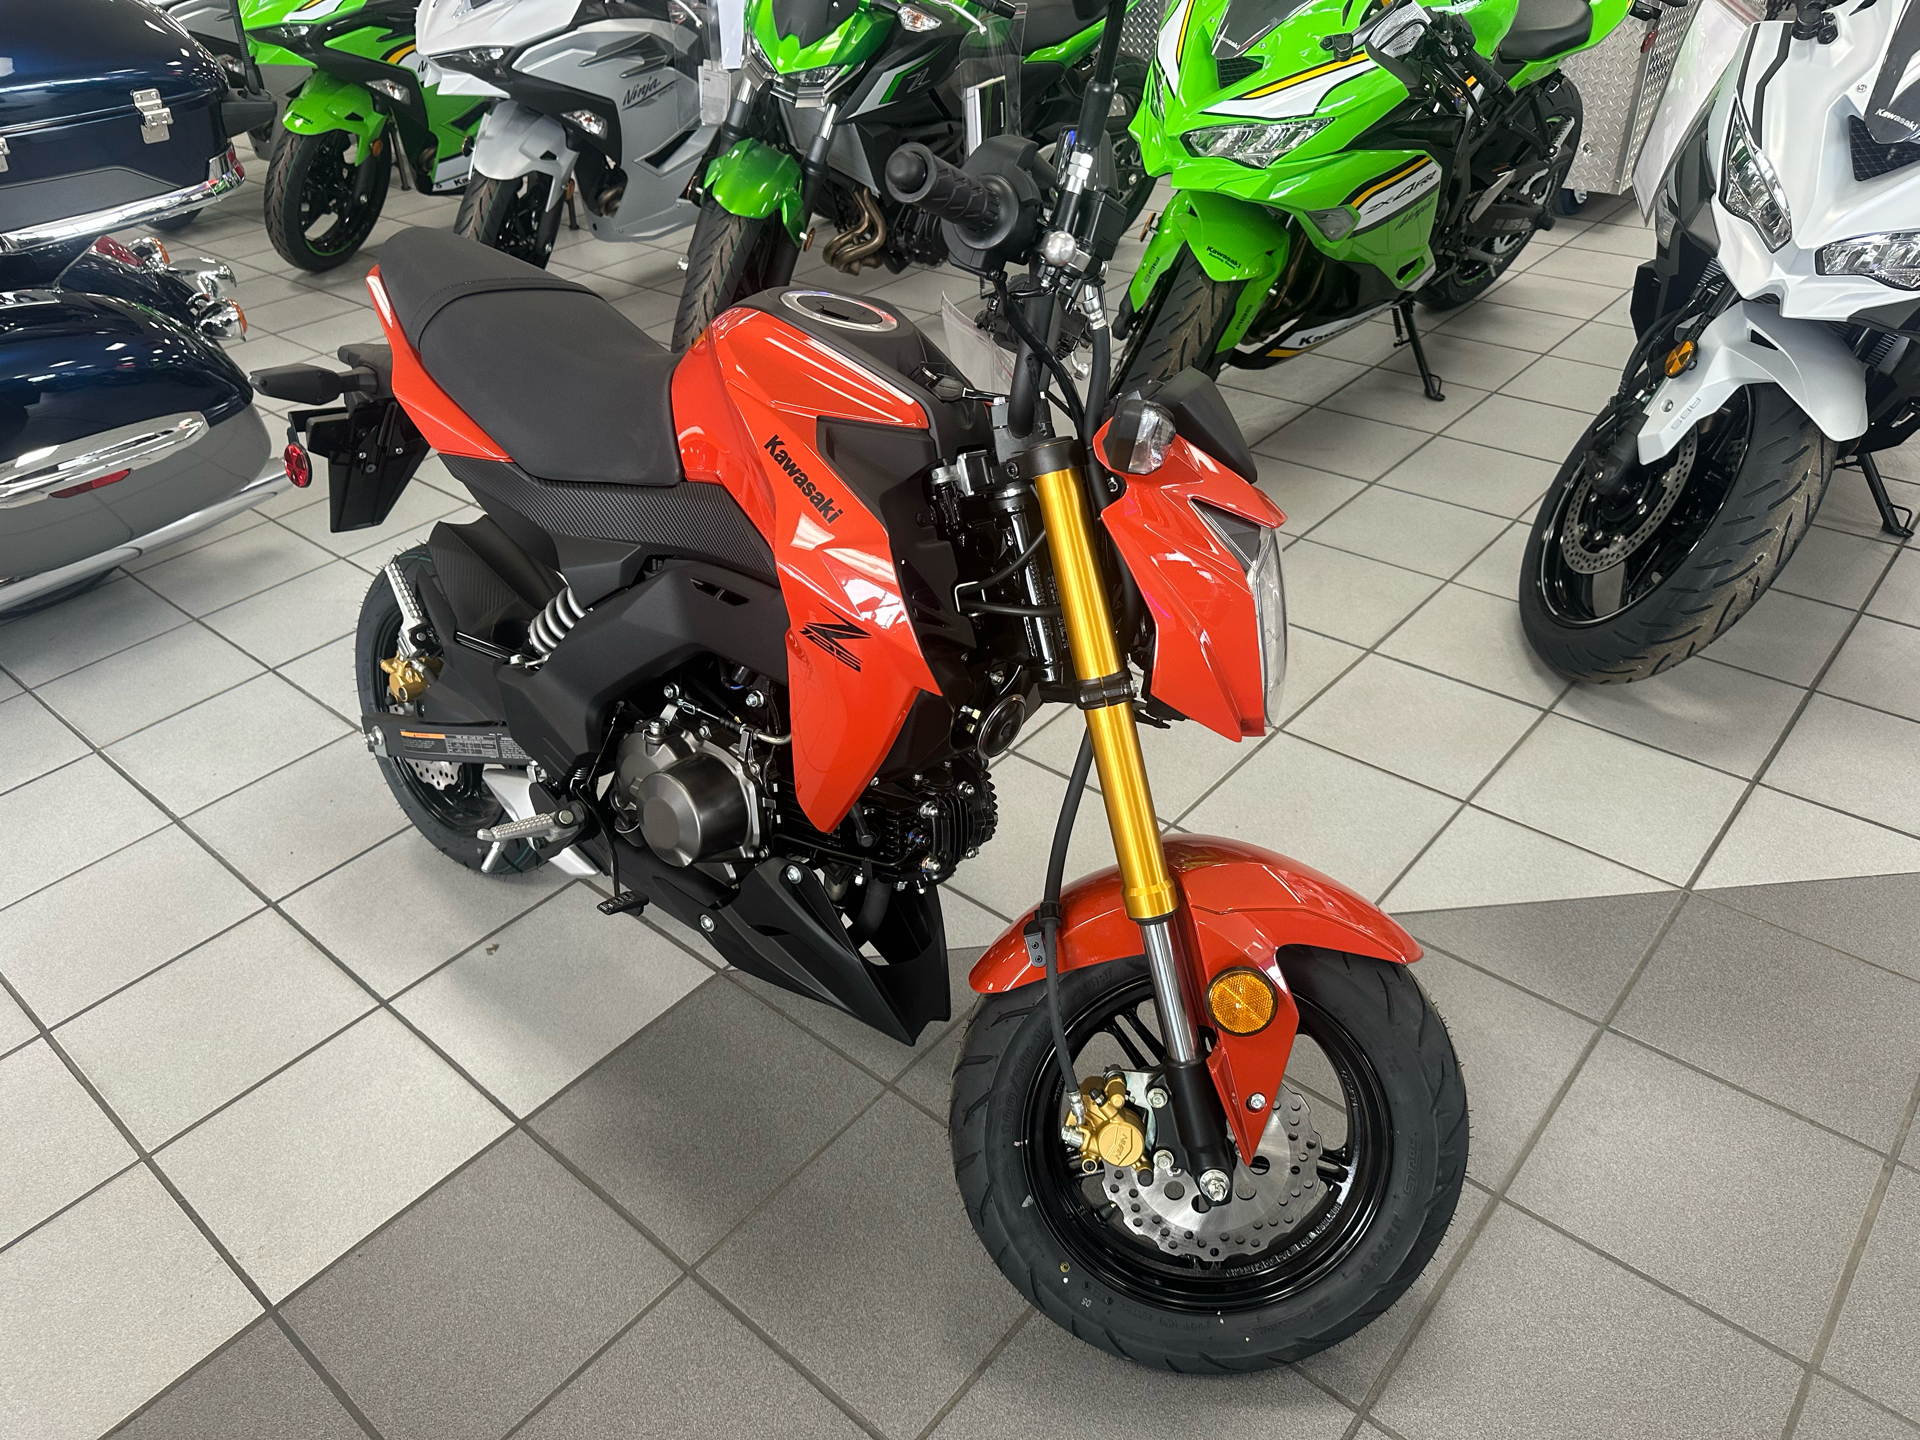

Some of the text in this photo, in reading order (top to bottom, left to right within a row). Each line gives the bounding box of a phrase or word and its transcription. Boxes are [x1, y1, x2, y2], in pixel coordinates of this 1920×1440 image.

[622, 75, 662, 106] Ninja
[1874, 107, 1919, 132] Kawasaki
[1205, 245, 1242, 270] Kawasaki
[1671, 396, 1701, 431] ABS
[763, 434, 844, 525] Kawasaki
